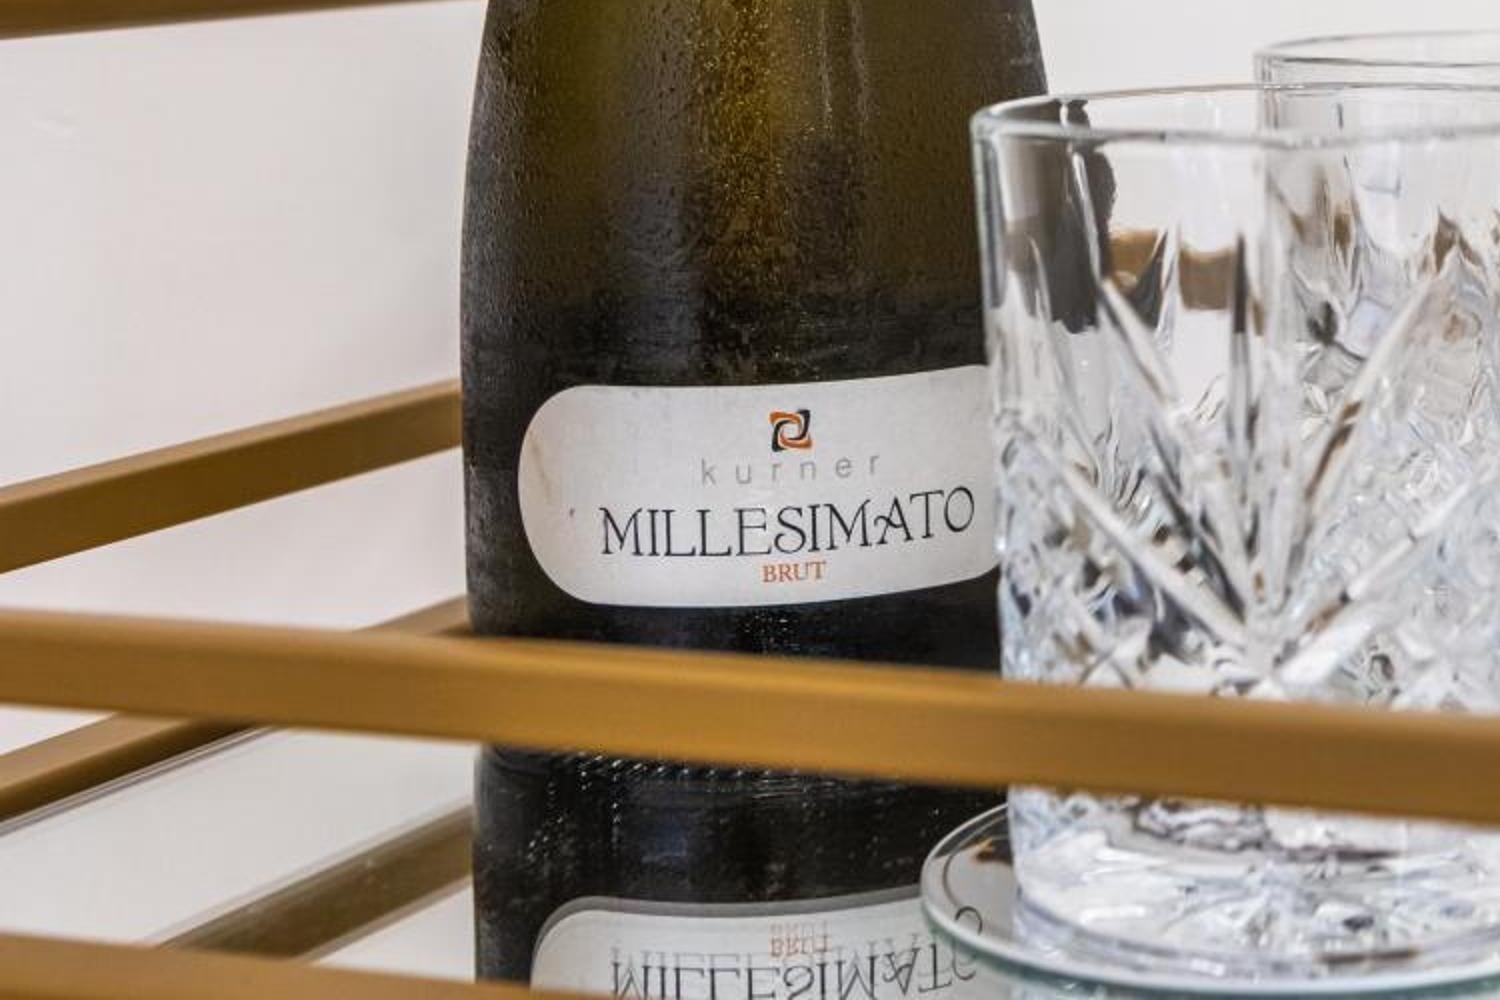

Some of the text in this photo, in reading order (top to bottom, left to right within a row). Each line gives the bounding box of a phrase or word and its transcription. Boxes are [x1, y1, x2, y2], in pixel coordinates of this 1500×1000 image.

[701, 453, 880, 485] kurner
[600, 486, 976, 557] MILLESIMATO
[762, 561, 828, 584] BRUT
